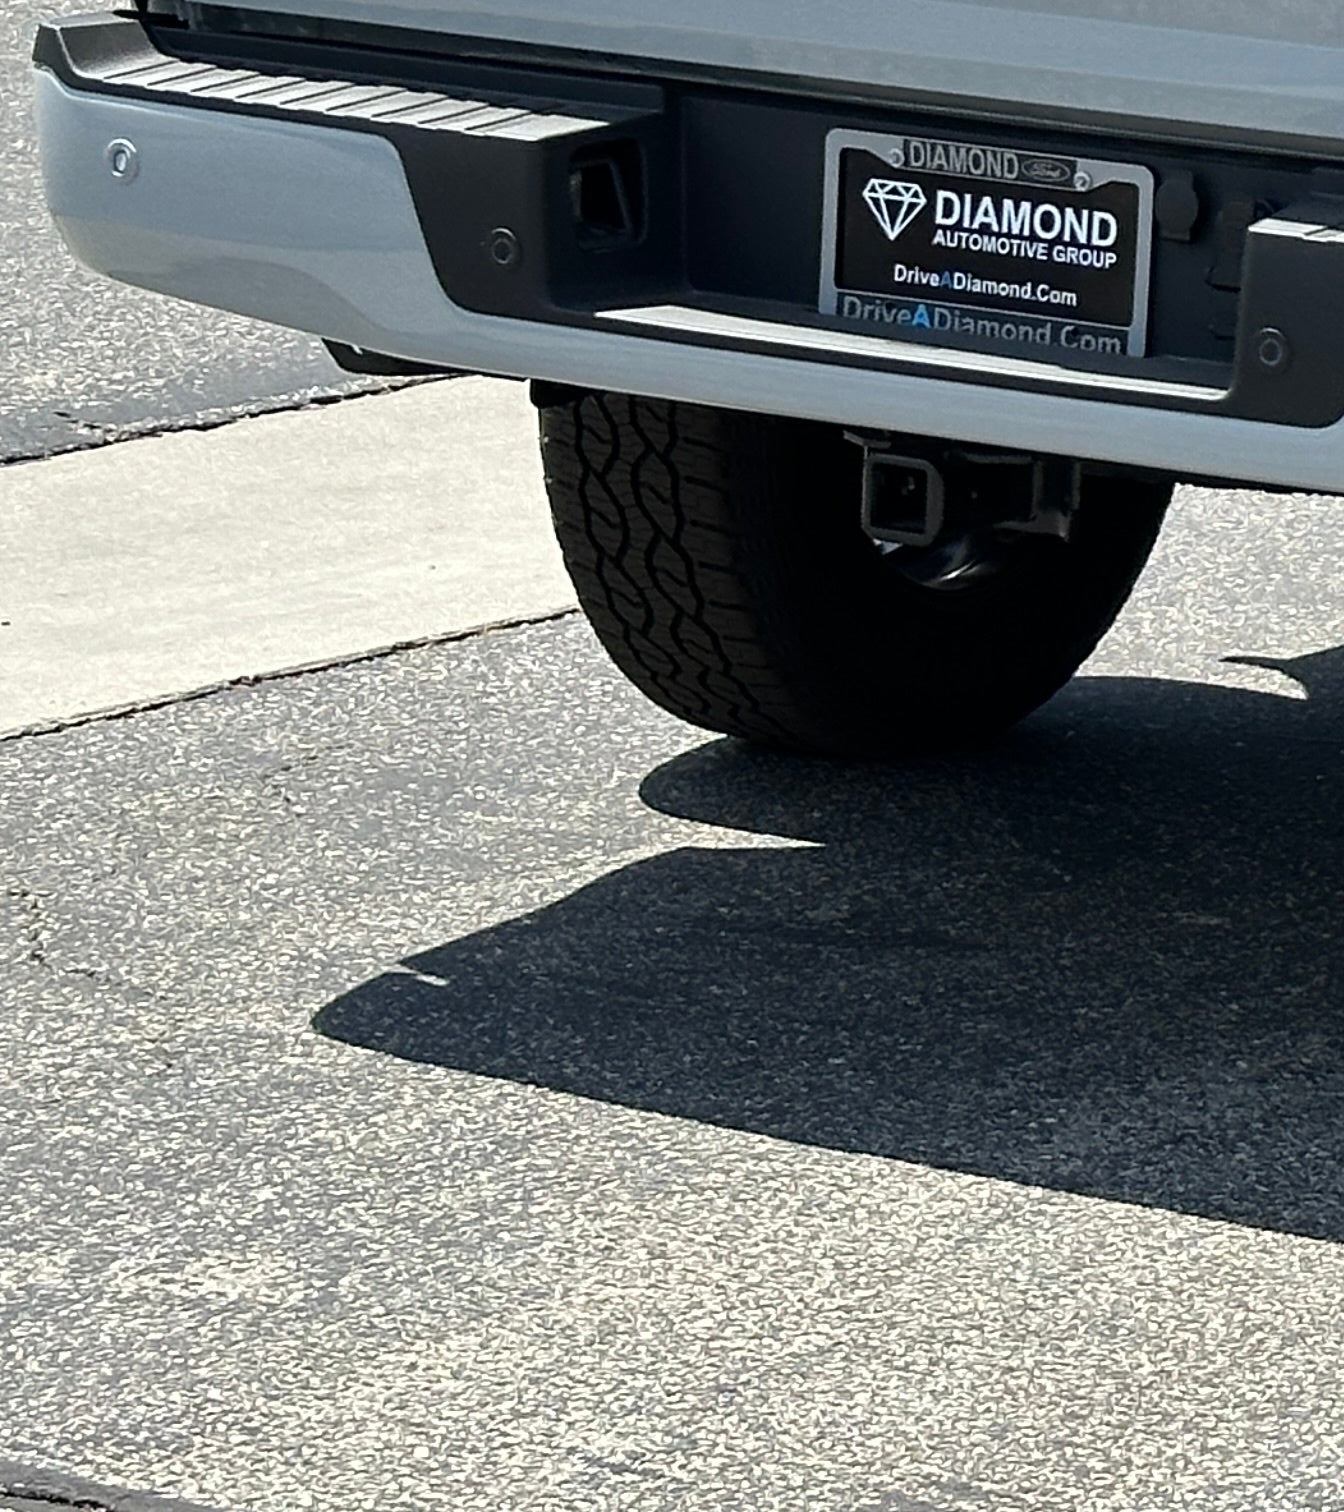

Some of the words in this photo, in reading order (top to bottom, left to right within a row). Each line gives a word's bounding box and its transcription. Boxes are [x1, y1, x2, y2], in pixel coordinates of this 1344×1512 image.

[909, 140, 1019, 181] DIAMOND
[934, 189, 1118, 247] DIAMOND
[932, 228, 1049, 261] AUTOMOTIVE
[1052, 244, 1118, 270] GROUP
[894, 263, 1078, 308] DriveADiamond.Com
[842, 295, 1122, 355] DriveADiamond.Com
